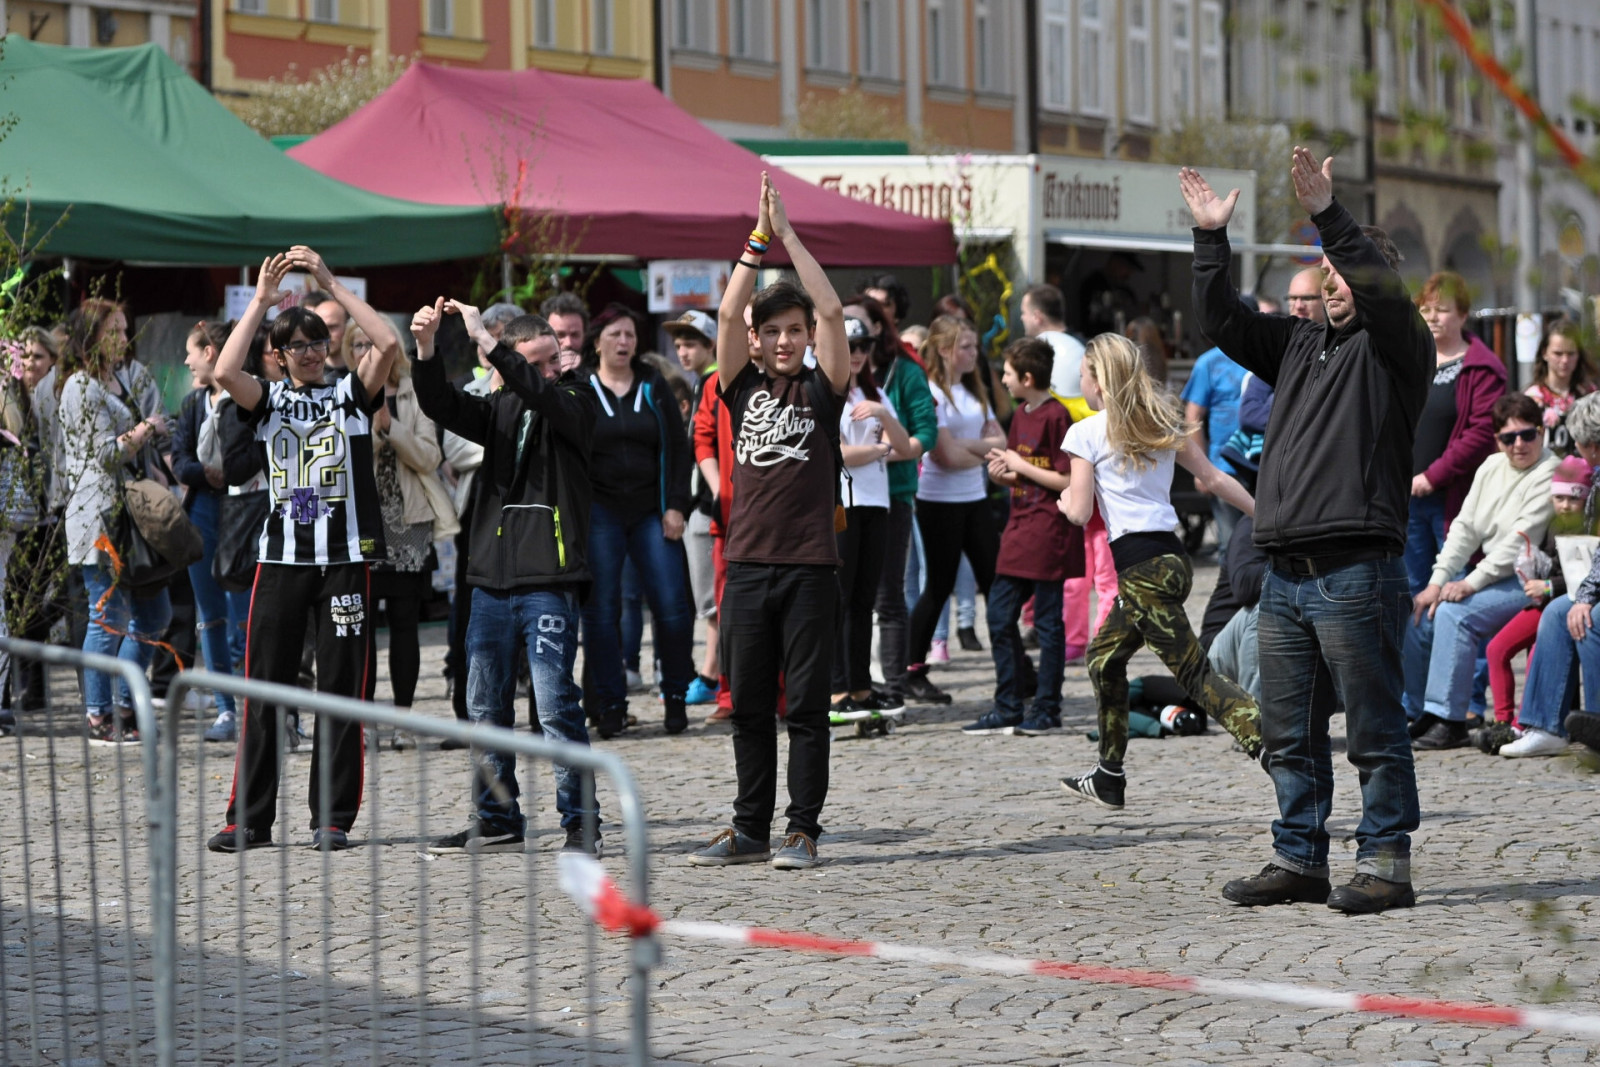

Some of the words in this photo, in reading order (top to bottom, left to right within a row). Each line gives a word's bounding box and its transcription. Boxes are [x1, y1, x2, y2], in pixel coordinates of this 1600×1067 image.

[820, 174, 973, 220] akonoš
[272, 423, 348, 503] 92
[330, 593, 362, 608] A88
